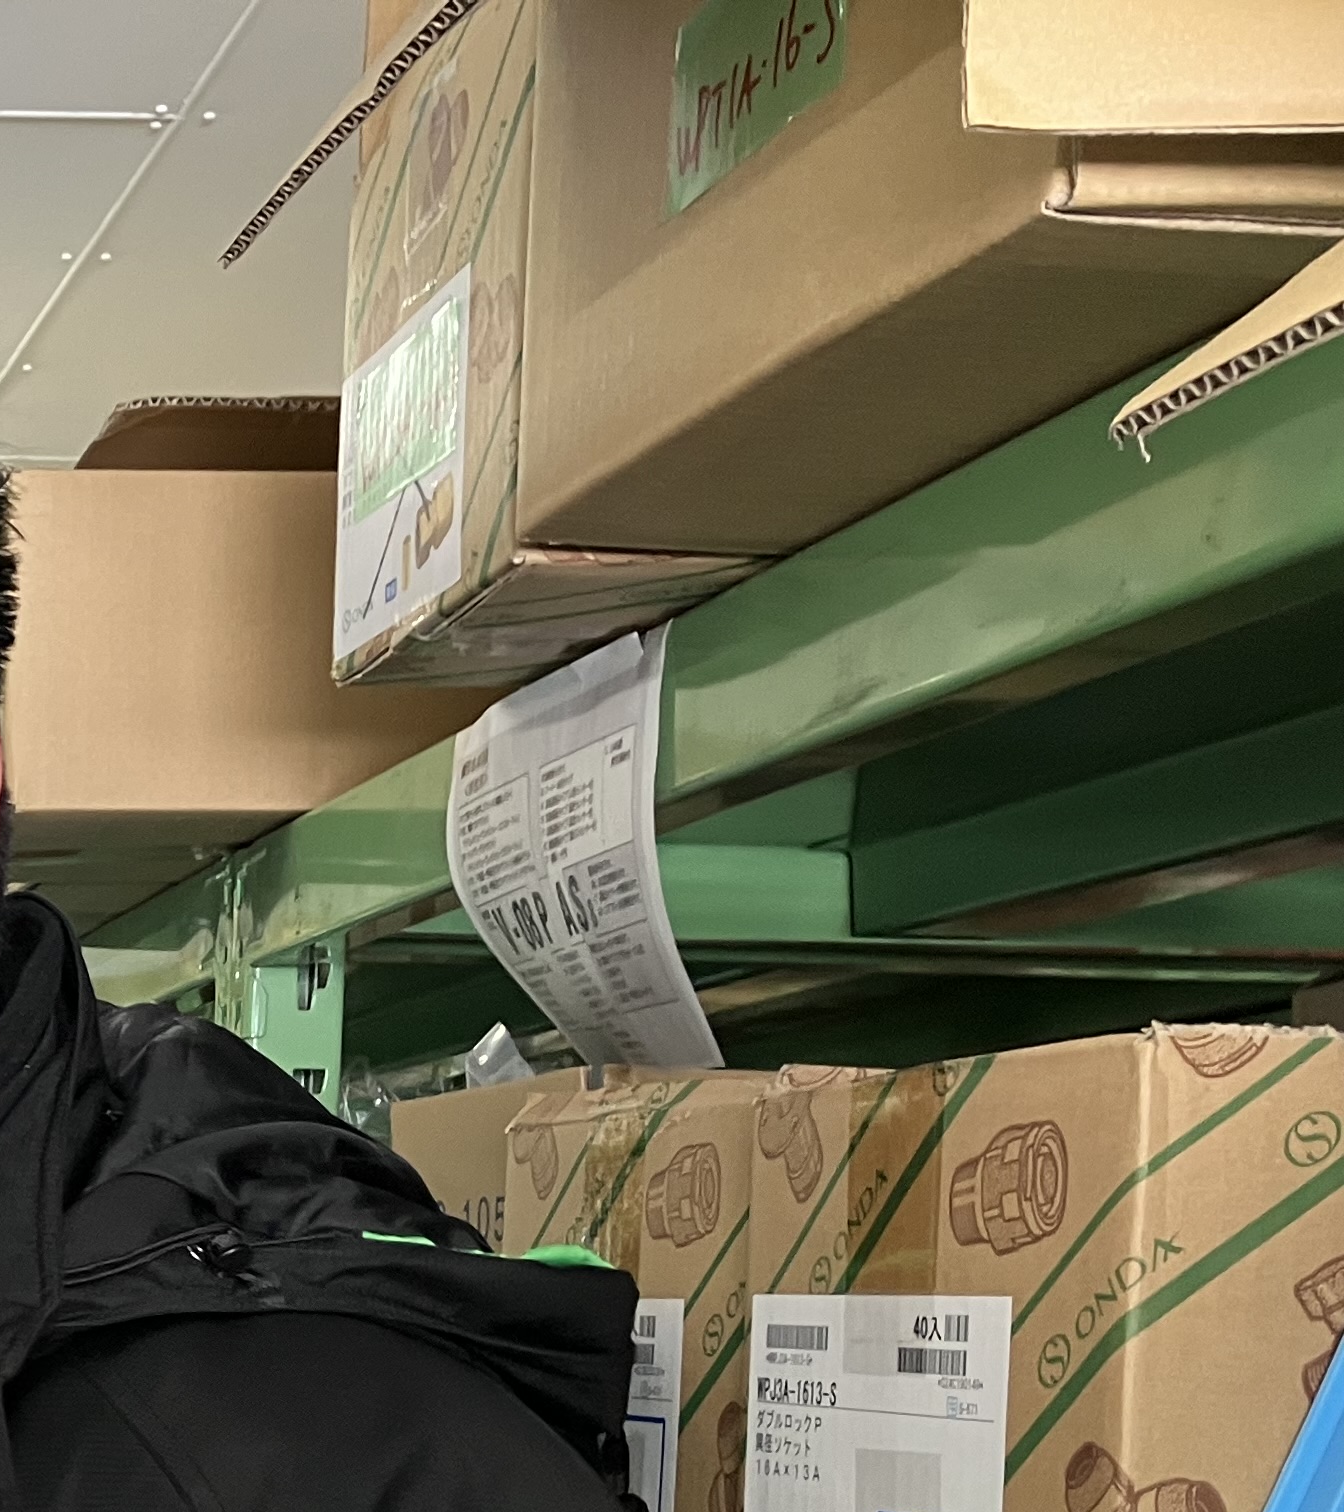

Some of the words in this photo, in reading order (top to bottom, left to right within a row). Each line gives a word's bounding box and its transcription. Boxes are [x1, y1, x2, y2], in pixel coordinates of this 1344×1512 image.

[833, 1168, 888, 1261] ONDA
[1075, 1230, 1185, 1340] ONDA
[913, 1314, 942, 1341] 40入
[757, 1376, 838, 1407] WPJ3A-1613-S
[756, 1409, 823, 1434] ダブルロックP
